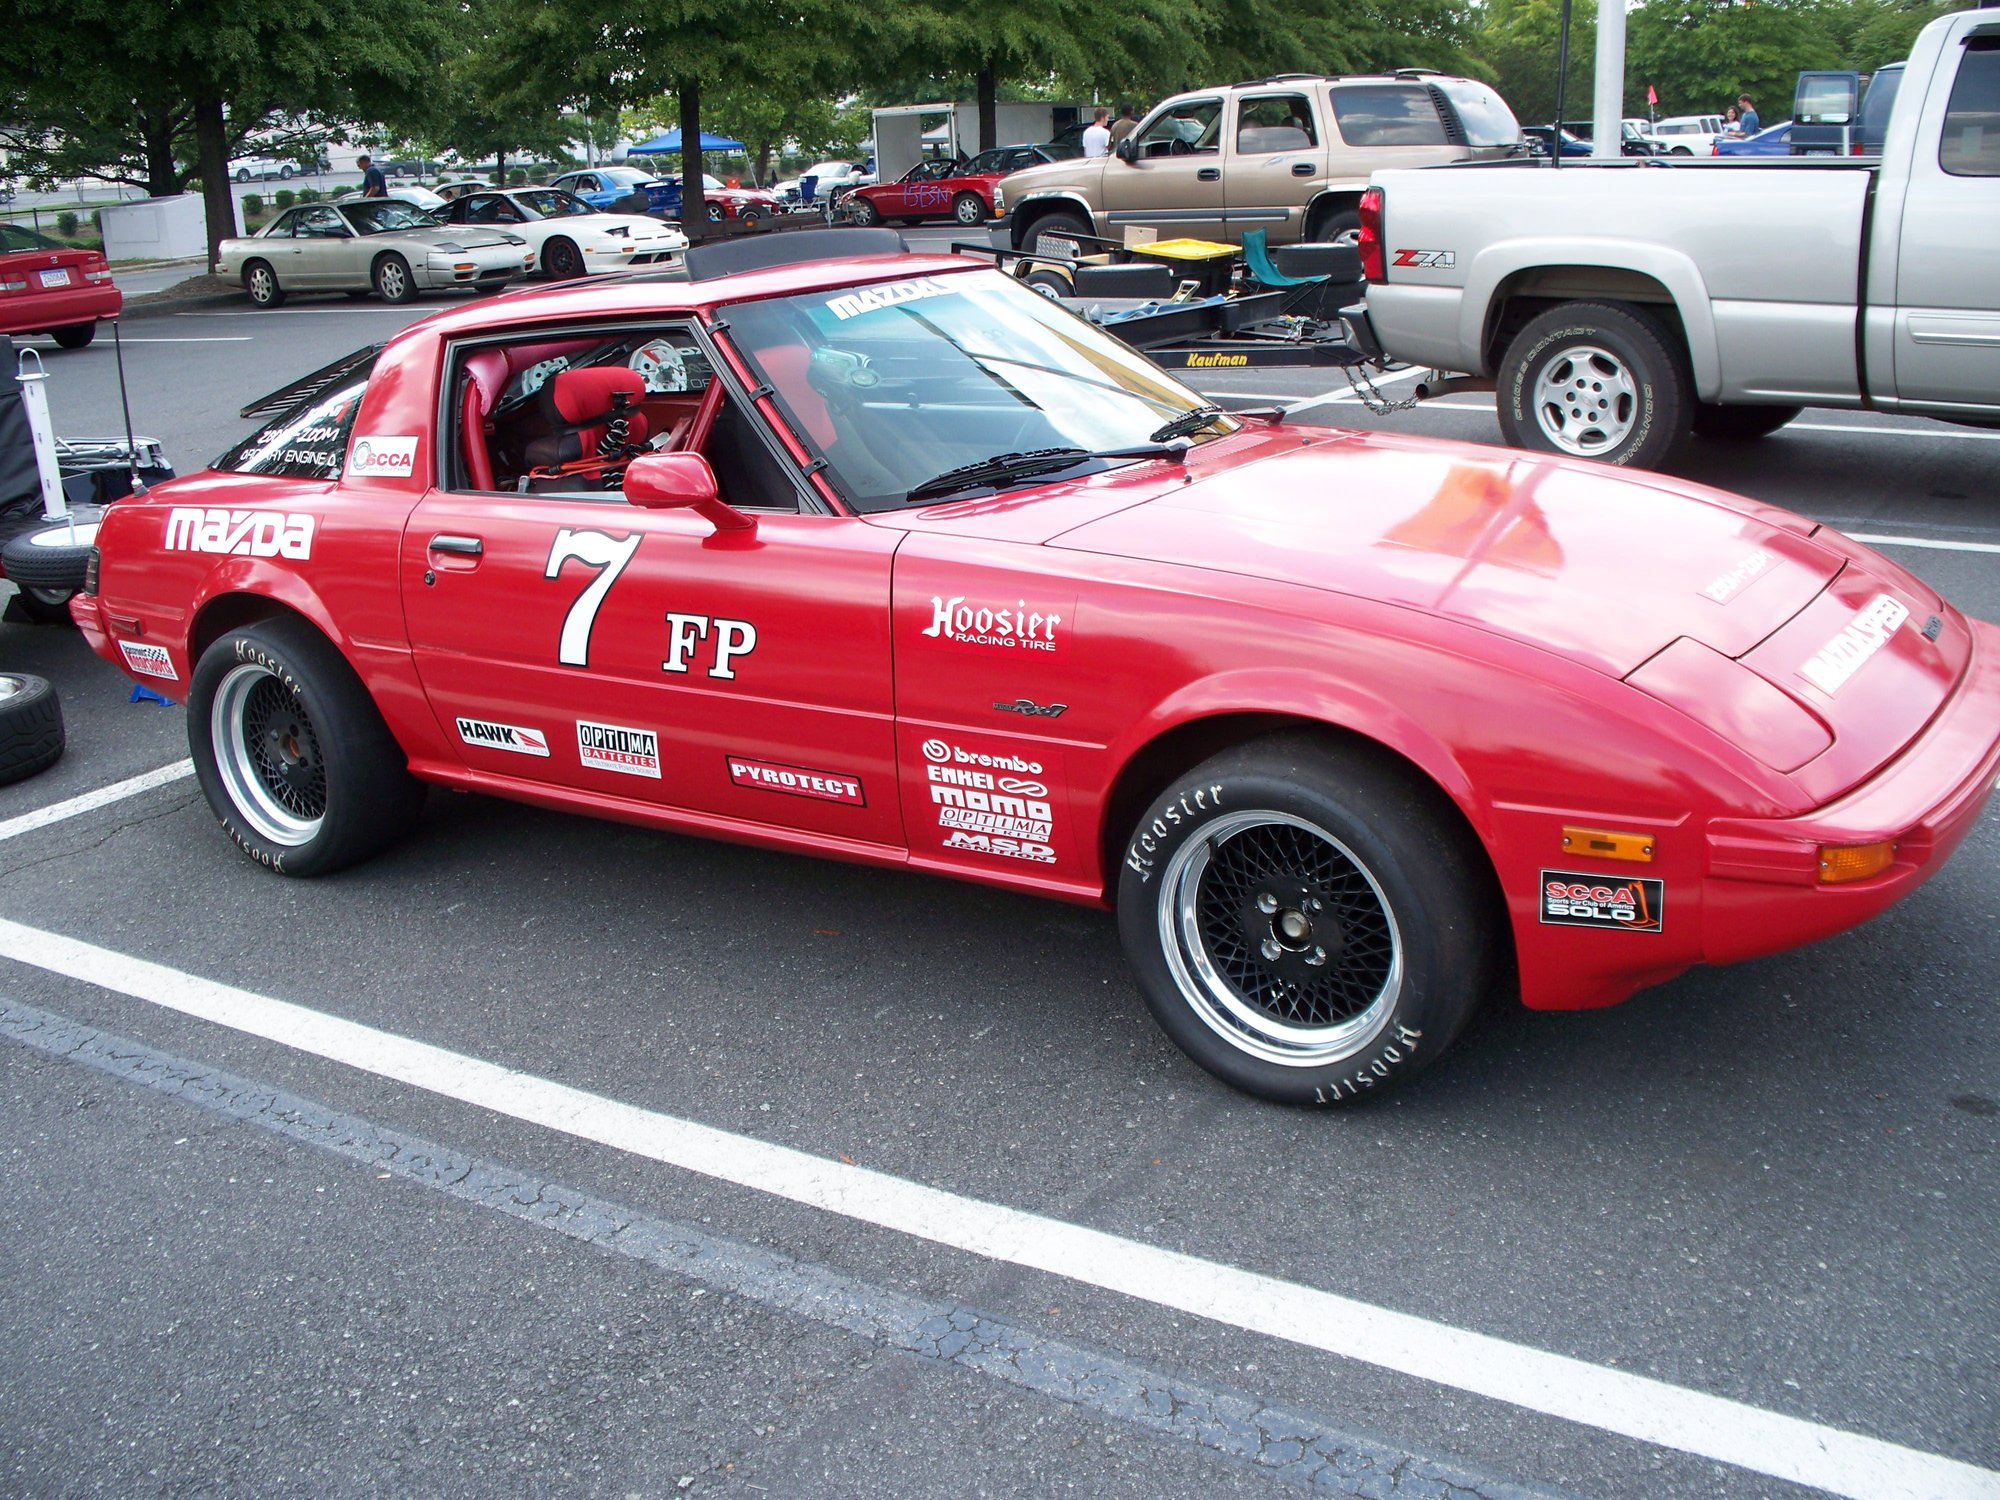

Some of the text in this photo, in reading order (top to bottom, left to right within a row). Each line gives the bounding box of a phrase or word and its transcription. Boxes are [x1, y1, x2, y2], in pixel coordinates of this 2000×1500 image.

[1392, 248, 1456, 267] Z71
[1187, 352, 1248, 367] Kaufman
[1513, 327, 1597, 421] CROSS CONTACT
[285, 449, 328, 466] ENGINE
[366, 452, 411, 467] SCCA
[544, 527, 645, 668] 7
[920, 595, 1062, 641] Hoosier
[662, 612, 757, 680] FP
[955, 632, 1056, 652] RACING TIRE
[1800, 593, 1911, 695] MAZDASPEED
[235, 640, 303, 695] Hoosier
[458, 720, 518, 745] HAWK
[581, 726, 655, 755] OPTIMA
[583, 748, 656, 768] BATTERIES
[954, 746, 1043, 775] brembo
[731, 763, 858, 797] PYROTECT
[927, 764, 995, 790] ENKEI
[942, 808, 1050, 835] OPTIMA
[1126, 783, 1224, 883] Hoosier
[219, 817, 287, 874] Hoosier
[950, 831, 1056, 857] MSD
[950, 842, 1048, 862] IGNITION
[1546, 881, 1637, 905] SCCA
[1548, 897, 1569, 905] Sports
[1547, 904, 1636, 921] SOLO
[1315, 1016, 1423, 1104] Hoosier
